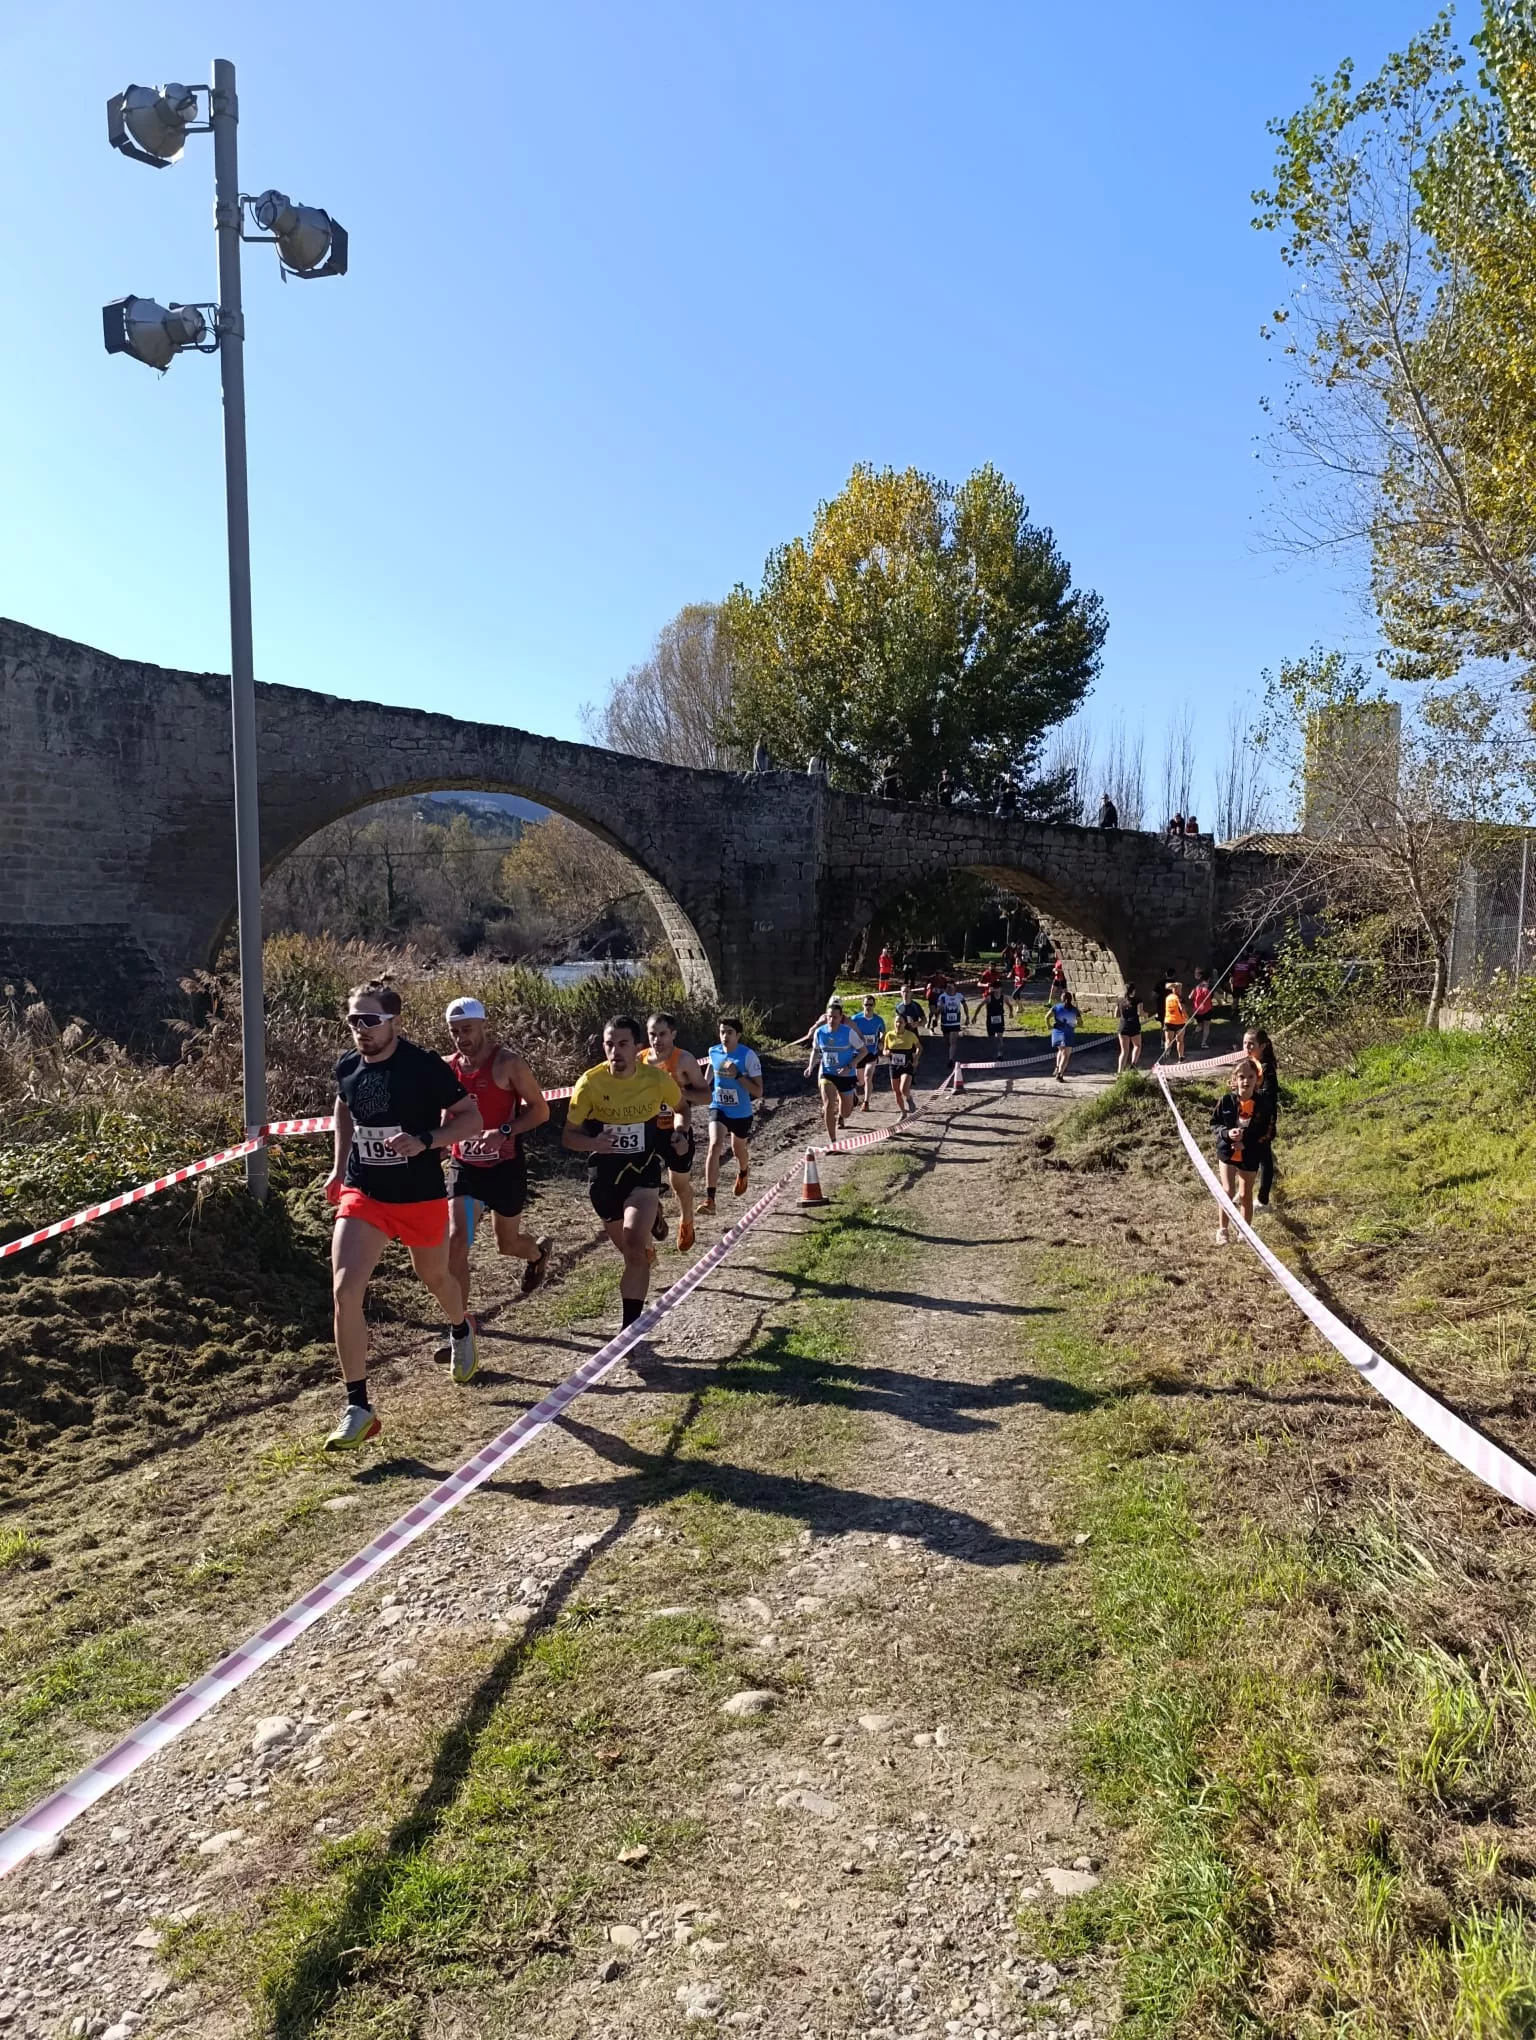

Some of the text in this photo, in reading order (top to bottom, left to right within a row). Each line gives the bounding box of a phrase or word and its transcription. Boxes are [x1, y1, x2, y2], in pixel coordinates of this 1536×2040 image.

[719, 1094, 735, 1103] 195
[612, 1134, 639, 1148] 263
[363, 1140, 398, 1158] 199
